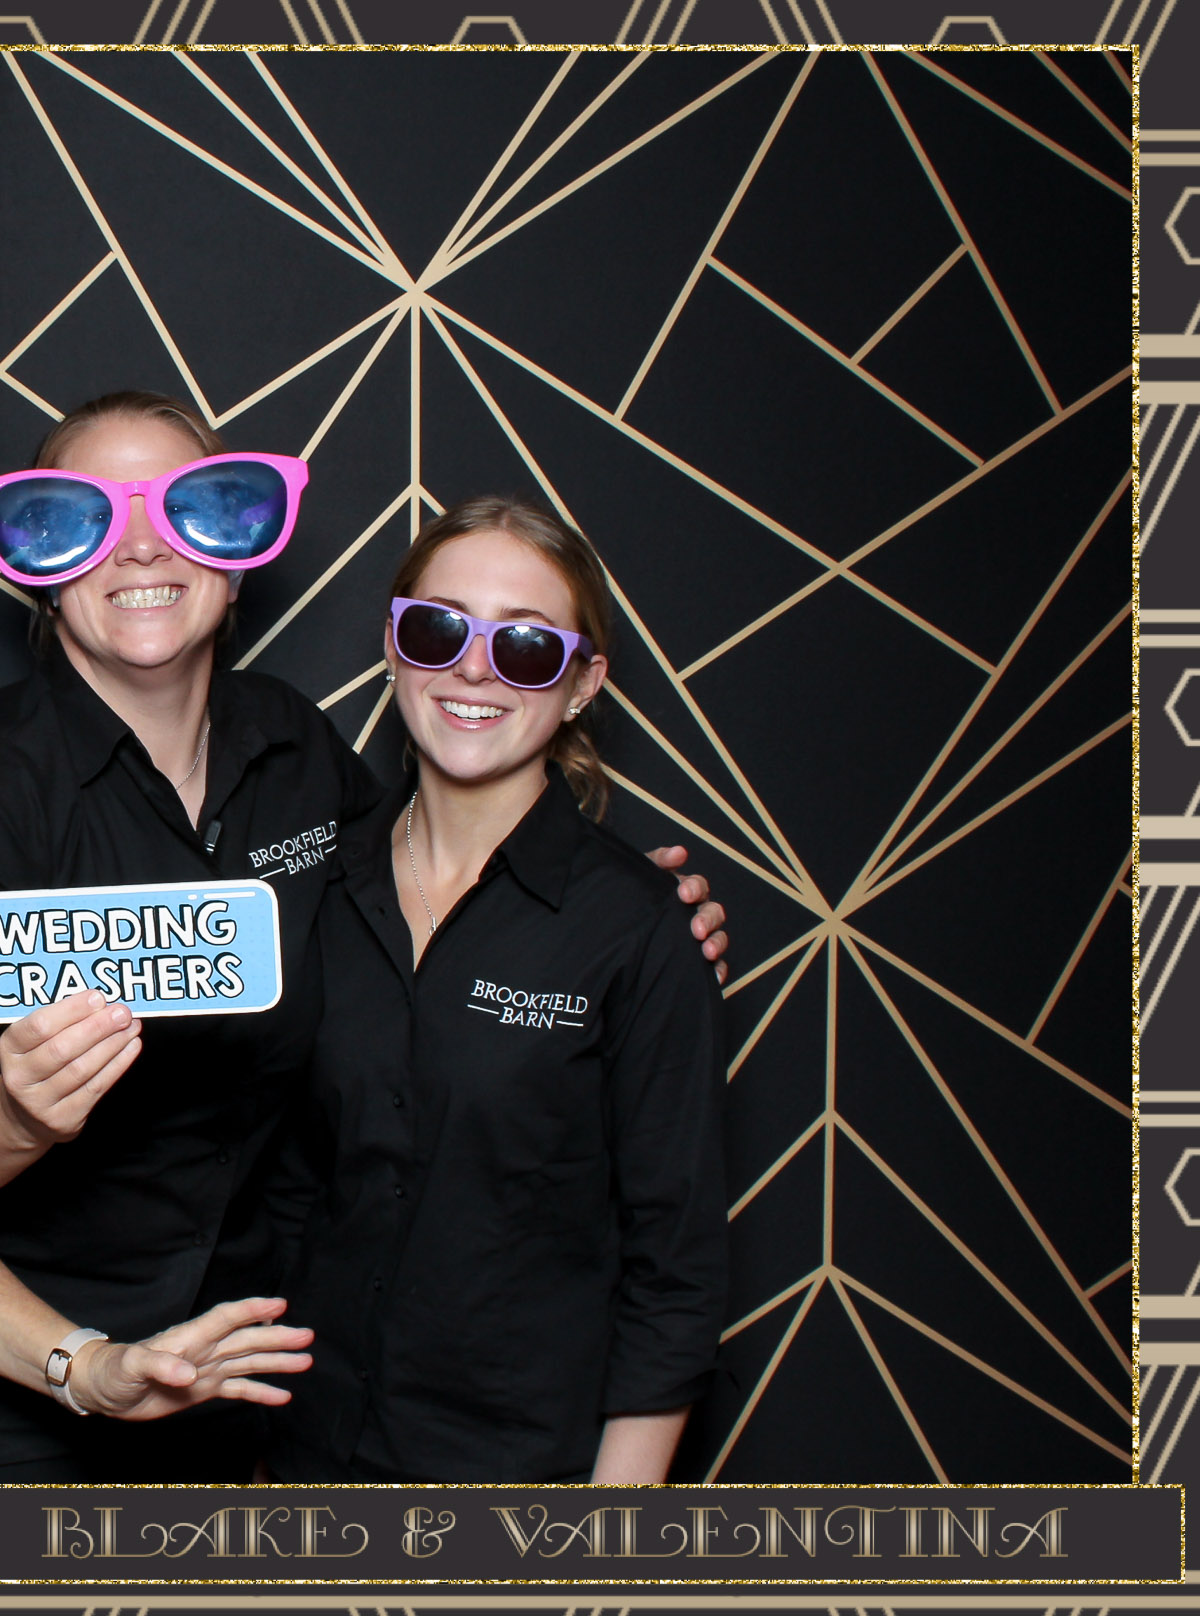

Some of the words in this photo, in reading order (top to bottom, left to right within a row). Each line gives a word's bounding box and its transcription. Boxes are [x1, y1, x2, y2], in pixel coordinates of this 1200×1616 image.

[248, 821, 337, 868] BROOKFIELD
[284, 847, 325, 875] BARN
[471, 979, 588, 1014] BROOKFIELD
[499, 1006, 555, 1029] BARN
